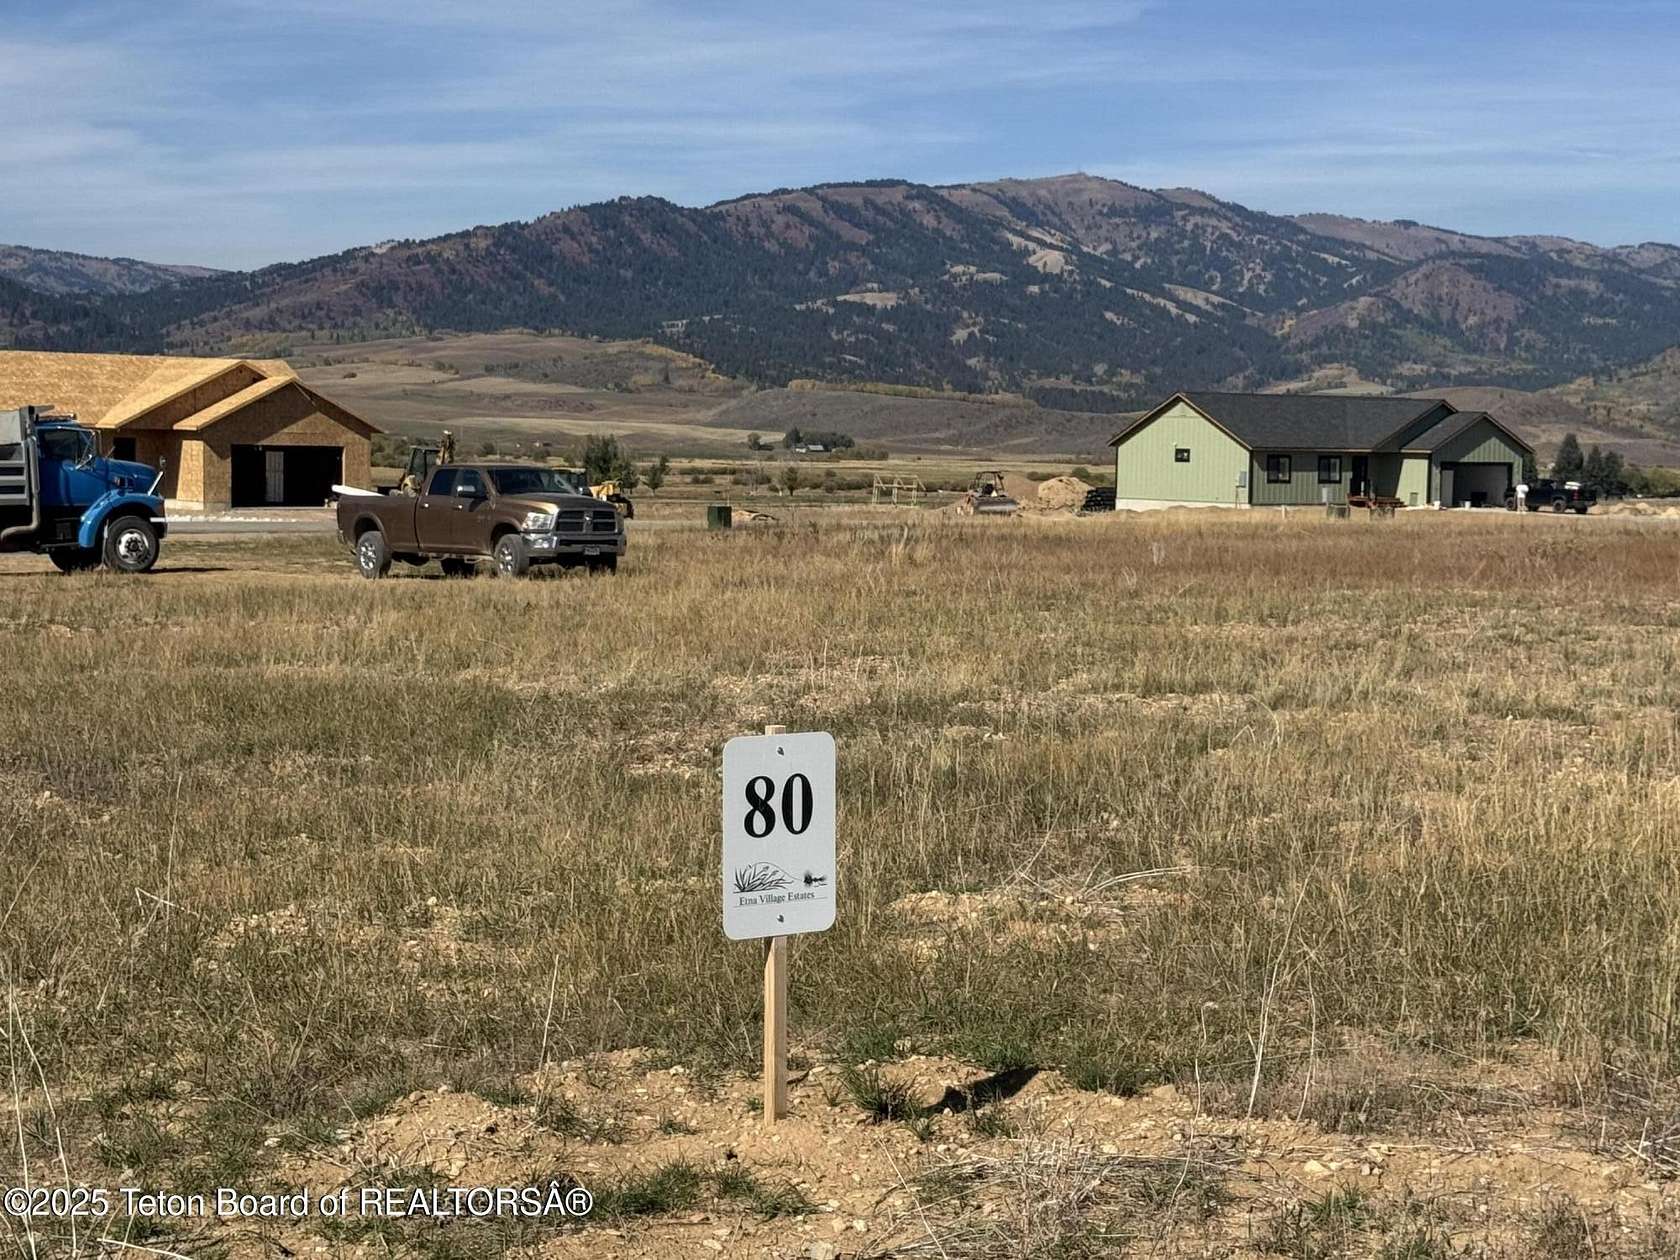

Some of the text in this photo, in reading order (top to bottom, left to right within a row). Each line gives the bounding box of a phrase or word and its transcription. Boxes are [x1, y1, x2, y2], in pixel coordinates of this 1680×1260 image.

[744, 773, 813, 839] 80
[759, 894, 785, 904] Village
[787, 891, 815, 901] Estates
